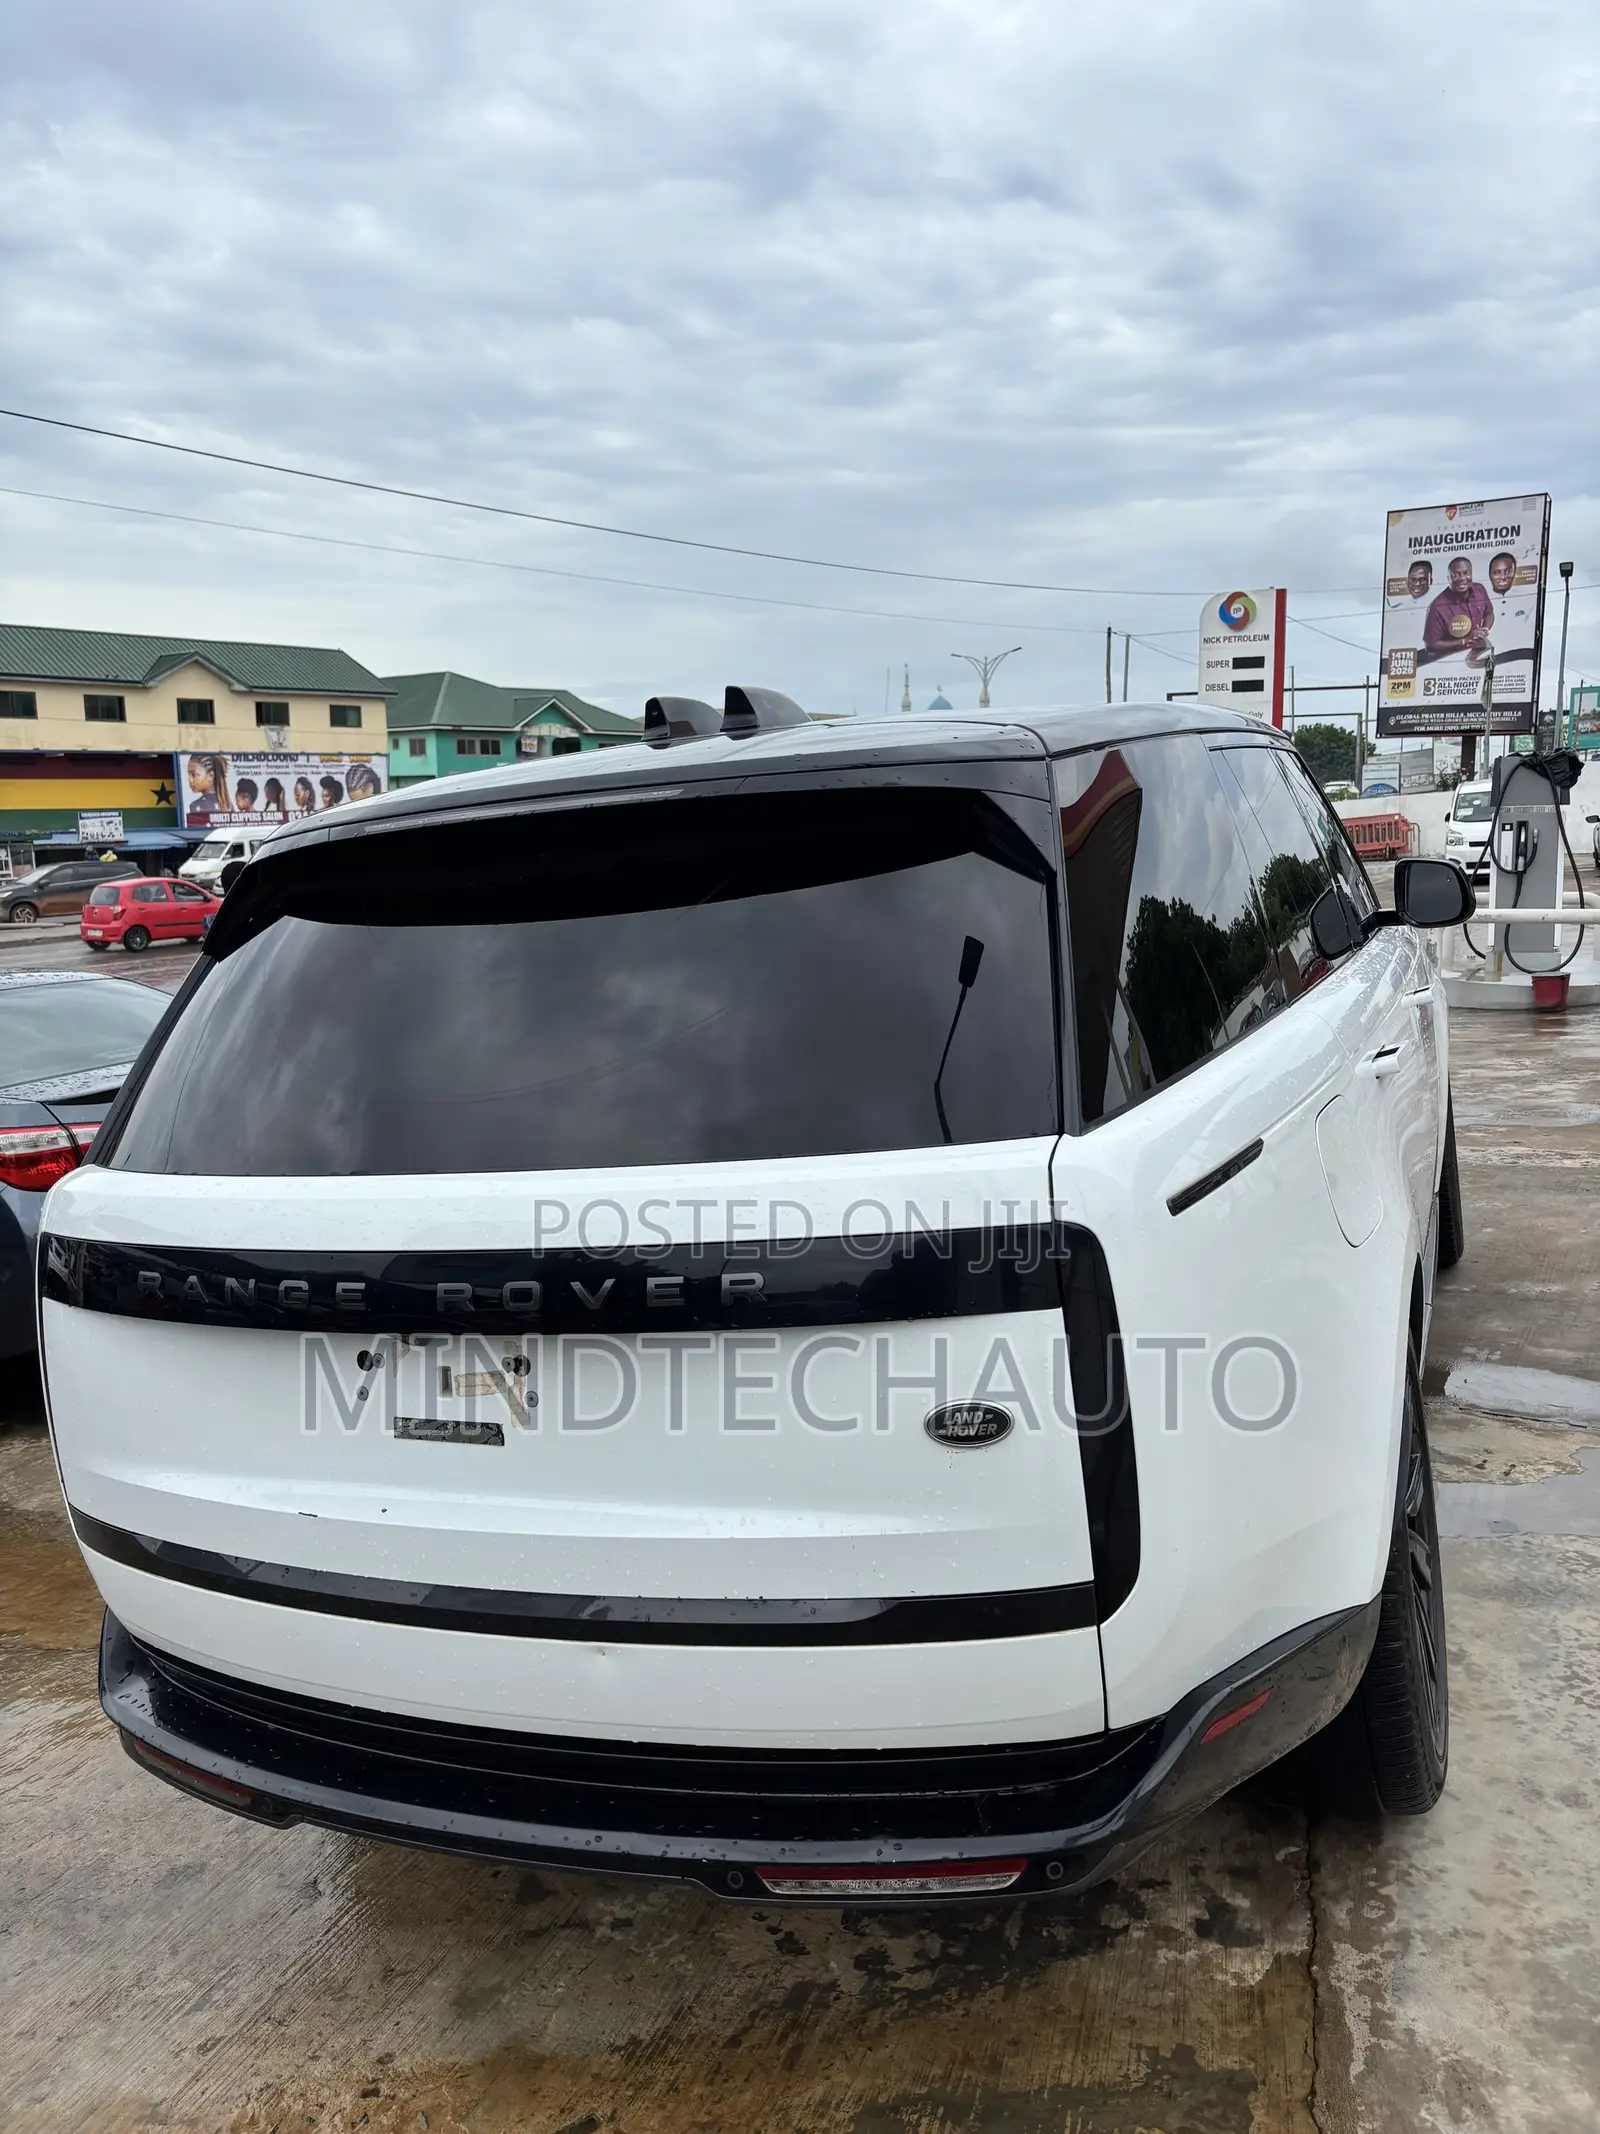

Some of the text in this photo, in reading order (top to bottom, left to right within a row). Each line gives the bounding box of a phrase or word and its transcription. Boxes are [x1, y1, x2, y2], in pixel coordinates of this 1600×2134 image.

[1408, 524, 1521, 548] INAUGURATION
[1412, 538, 1515, 556] OF NEW CHURCH BUILDING
[1203, 633, 1270, 645] NICK PETROLEUM
[1391, 651, 1414, 660] 14TH
[1206, 660, 1230, 669] SUPER
[1390, 659, 1414, 668] JUNE
[1390, 667, 1414, 676] 2026
[1205, 683, 1230, 692] DIESEL
[1391, 681, 1411, 690] 2PM
[1424, 679, 1435, 695] 3
[1453, 681, 1479, 689] NIGHT
[1436, 688, 1477, 696] SERVICES
[209, 813, 230, 823] MULTI
[231, 812, 262, 822] CLIPPERS
[262, 811, 283, 821] SALON
[136, 1270, 769, 1315] RANGE ROVER
[943, 1411, 984, 1425] LAND
[947, 1423, 998, 1438] ROVER
